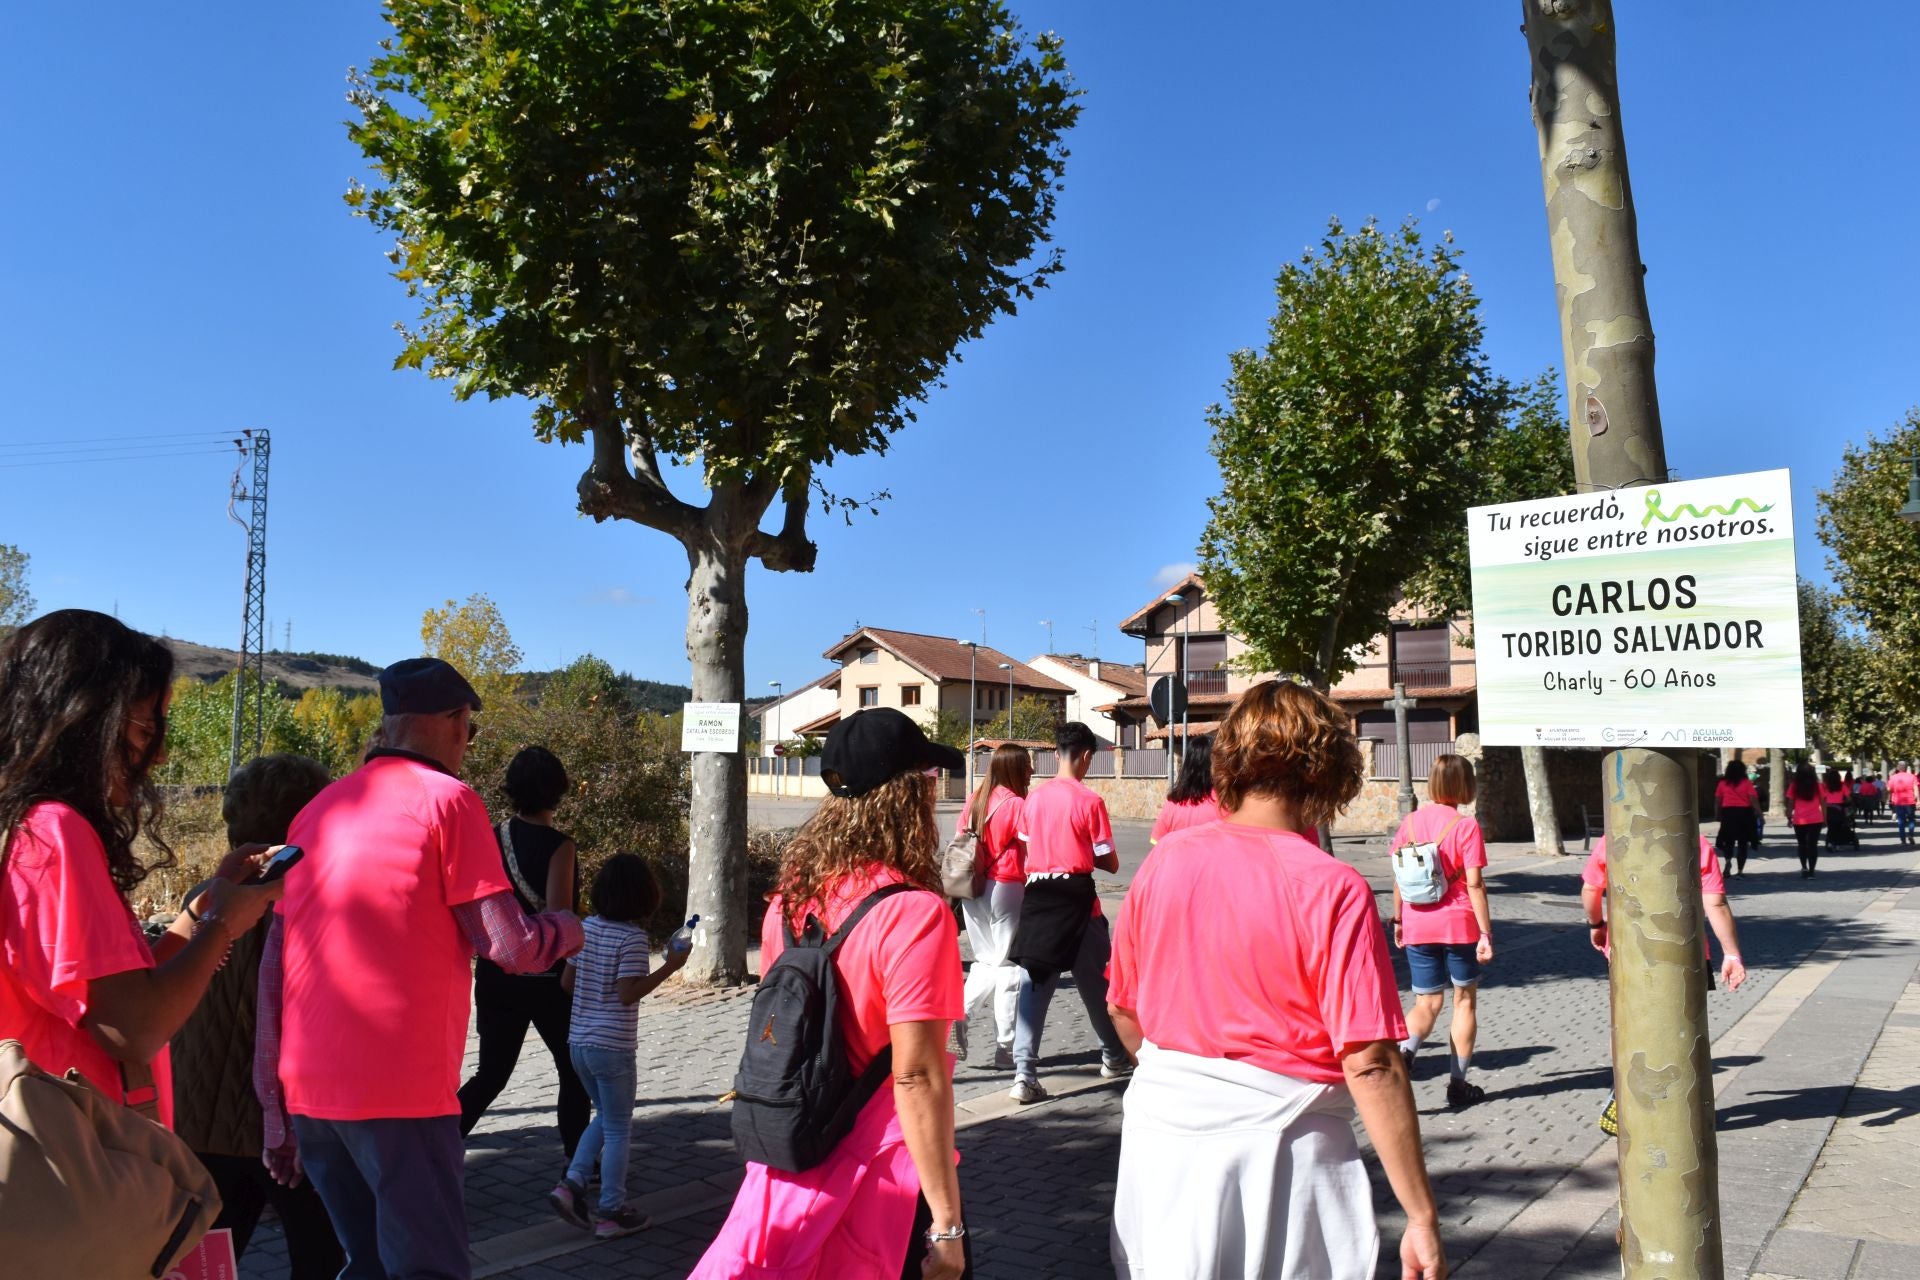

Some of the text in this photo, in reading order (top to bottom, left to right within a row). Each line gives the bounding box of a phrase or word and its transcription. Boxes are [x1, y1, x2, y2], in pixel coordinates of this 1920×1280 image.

[1487, 513, 1511, 532] Tu
[1524, 518, 1775, 561] sigue entre nosotros.
[1551, 574, 1697, 617] CARLOS
[1501, 619, 1764, 658] TORIBIO SALVADOR
[1543, 669, 1603, 696] Charly
[1623, 667, 1656, 689] 60
[1663, 667, 1717, 689] Años
[1692, 728, 1733, 736] AGUILAR
